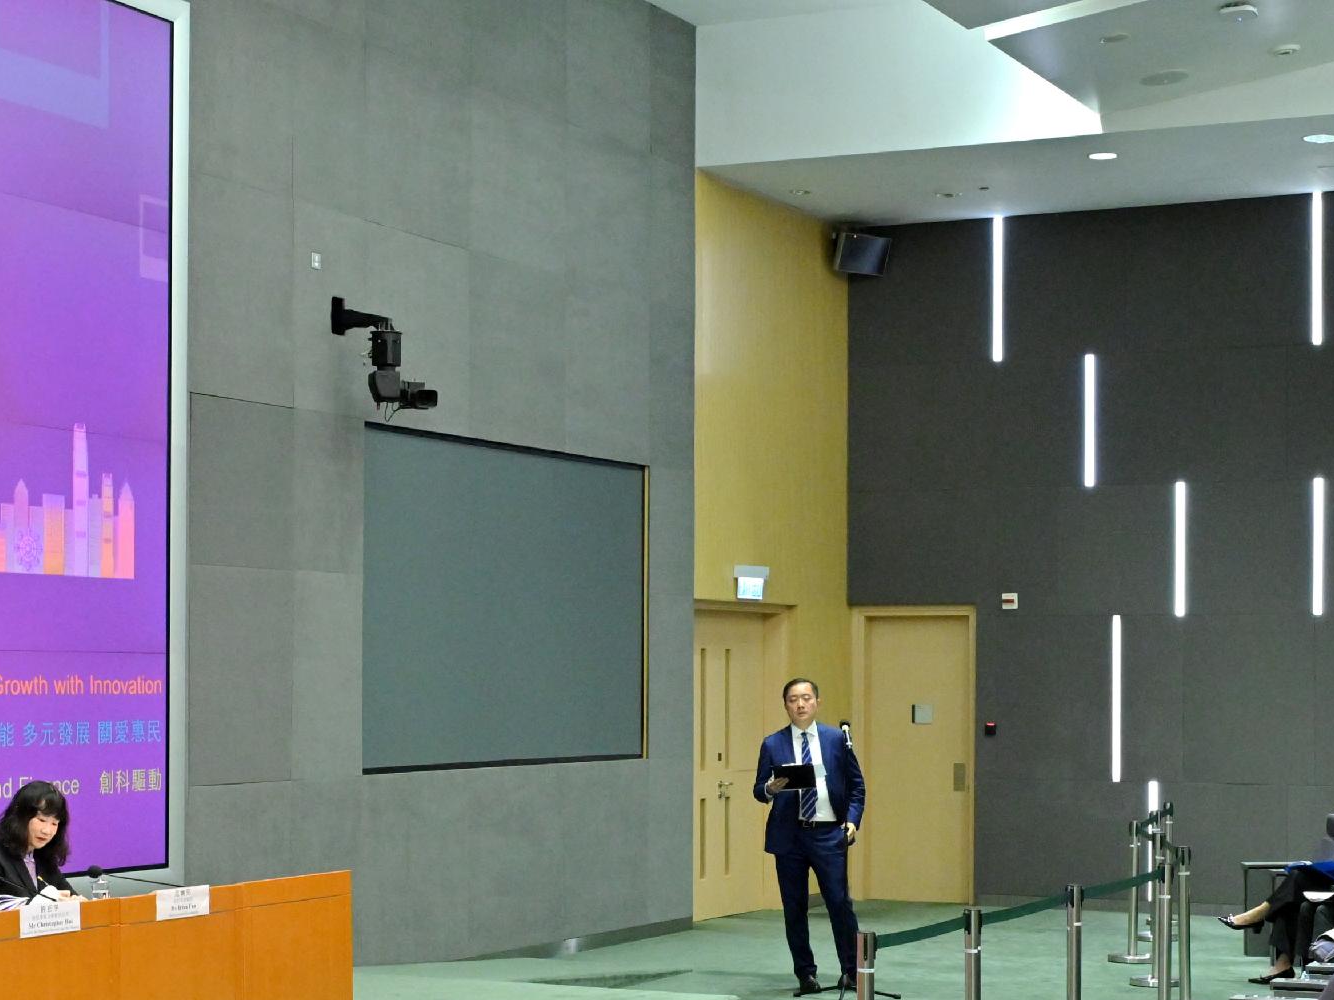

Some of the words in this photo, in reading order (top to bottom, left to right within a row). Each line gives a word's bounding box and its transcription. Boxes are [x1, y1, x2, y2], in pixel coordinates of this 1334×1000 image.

[54, 675, 85, 696] with
[89, 675, 163, 696] Innovation
[23, 722, 90, 746] 多元發展
[98, 720, 161, 744] 關愛惠民
[99, 768, 162, 795] 創科驅動
